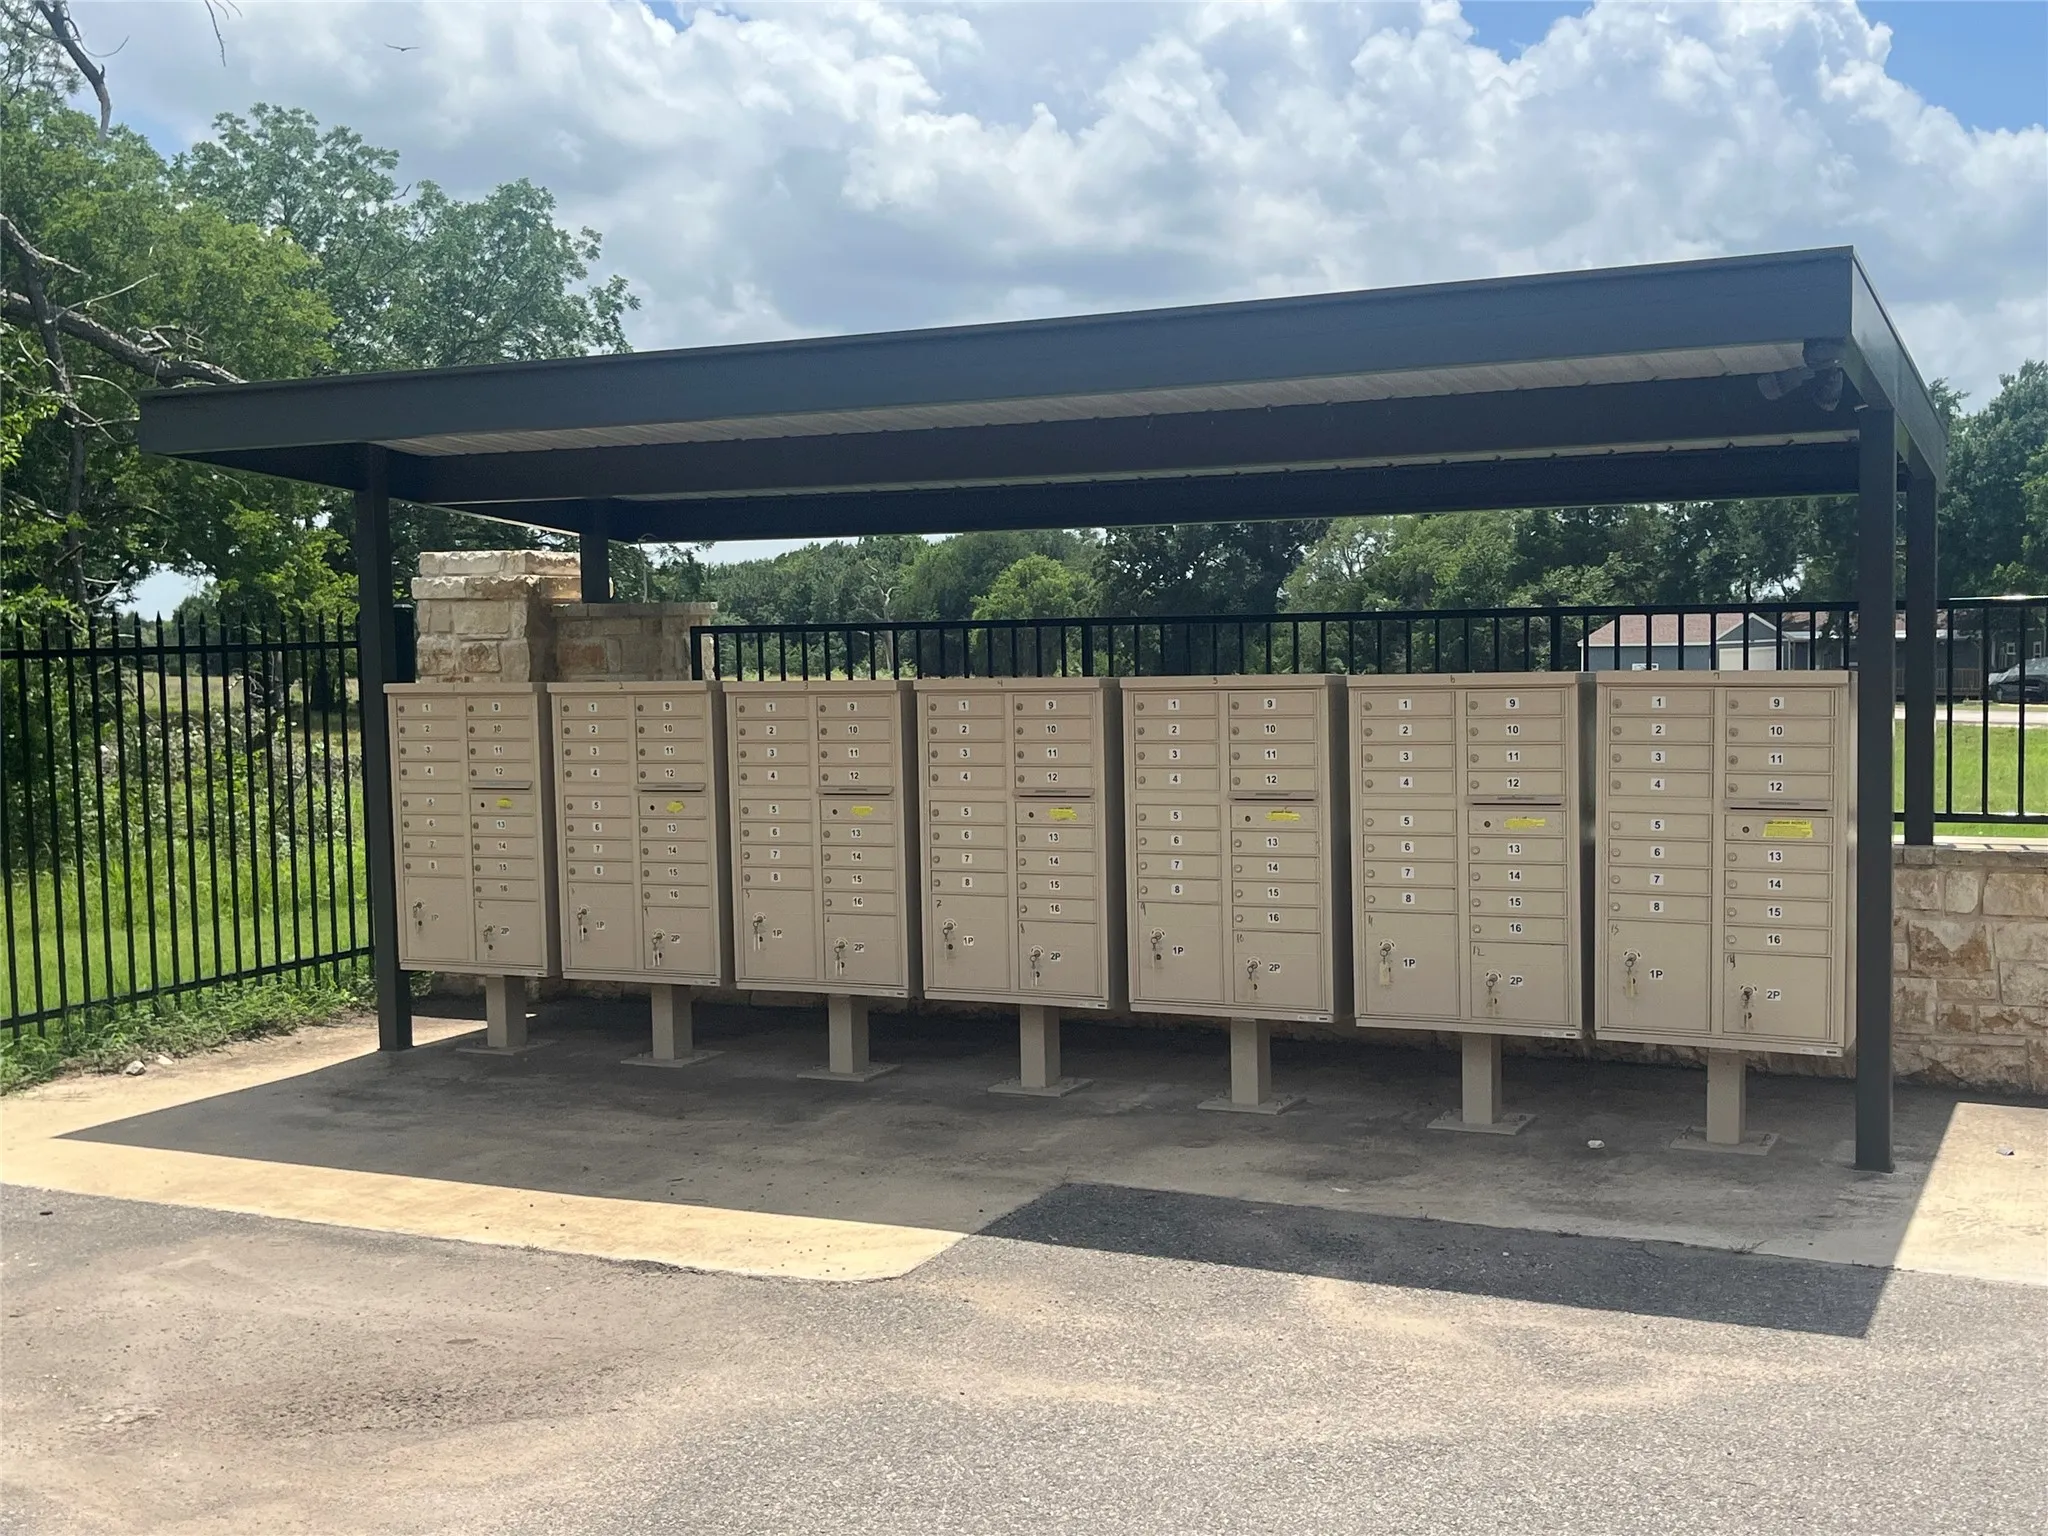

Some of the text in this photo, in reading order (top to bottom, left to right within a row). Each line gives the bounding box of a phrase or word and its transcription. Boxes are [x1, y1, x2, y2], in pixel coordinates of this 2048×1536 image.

[804, 682, 808, 690] 3
[1267, 700, 1272, 708] 9
[1403, 700, 1408, 708] 1
[1509, 699, 1515, 707] 9
[1656, 698, 1661, 706] 1
[1774, 698, 1780, 707] 9
[1266, 725, 1276, 733] 10
[1403, 726, 1408, 734] 2
[1508, 726, 1518, 734] 10
[1656, 725, 1662, 734] 2
[1771, 726, 1782, 735] 10
[1173, 750, 1178, 758] 3
[1267, 750, 1276, 758] 11
[1403, 752, 1409, 761] 3
[1509, 752, 1518, 760] 11
[1656, 752, 1661, 761] 3
[1771, 754, 1782, 763] 11
[1173, 775, 1178, 783] 4
[1404, 778, 1409, 786] 4
[1509, 779, 1519, 787] 12
[1655, 780, 1660, 788] 4
[1770, 782, 1782, 791] 12
[1404, 817, 1410, 825] 5
[1655, 821, 1661, 829] 5
[1268, 838, 1278, 846] 13
[1405, 843, 1410, 851] 6
[1509, 845, 1520, 853] 13
[1654, 848, 1660, 856] 6
[1770, 852, 1781, 861] 13
[1175, 860, 1179, 868] 7
[1268, 863, 1278, 871] 14
[1405, 868, 1410, 876] 7
[1510, 871, 1520, 880] 14
[1654, 875, 1660, 884] 7
[1770, 880, 1781, 888] 14
[1175, 885, 1180, 894] 8
[1269, 888, 1279, 896] 15
[1406, 894, 1411, 902] 8
[1510, 898, 1521, 906] 15
[1654, 902, 1660, 911] 8
[1769, 908, 1780, 916] 15
[1511, 924, 1521, 932] 16
[1768, 935, 1780, 944] 16
[1173, 946, 1184, 954] 1P
[1404, 959, 1415, 967] 1P
[1269, 964, 1280, 972] 2P
[1651, 970, 1663, 978] 1P
[1510, 977, 1522, 985] 2P
[1767, 990, 1780, 999] 2P
